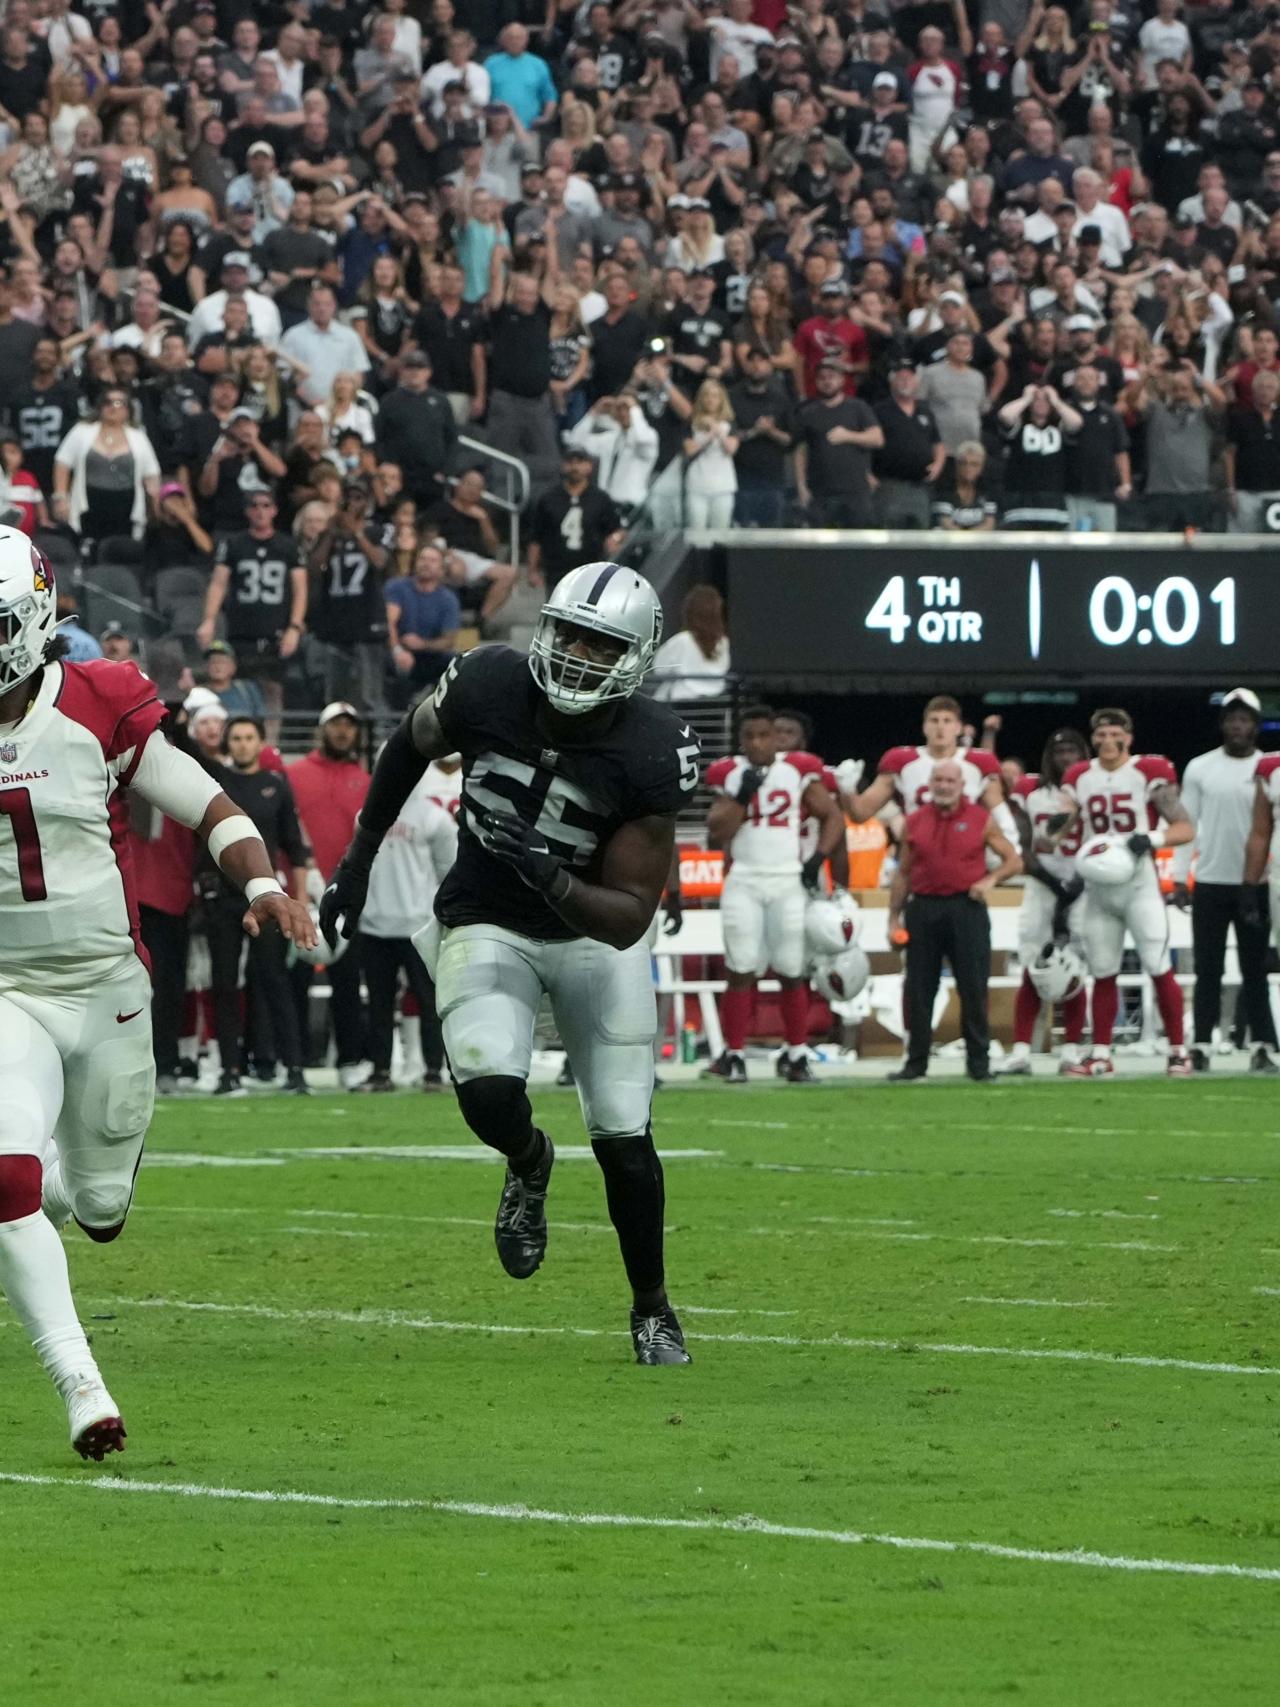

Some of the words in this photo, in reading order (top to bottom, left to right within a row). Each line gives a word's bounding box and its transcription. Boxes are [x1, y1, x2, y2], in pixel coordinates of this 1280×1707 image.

[20, 405, 63, 449] 52
[560, 506, 583, 551] 4
[236, 559, 286, 605] 39
[329, 553, 369, 597] 17
[864, 576, 910, 643] 4
[915, 576, 960, 608] TH
[1086, 575, 1233, 646] 0:01
[915, 611, 982, 644] QTR
[1086, 793, 1137, 835] 85
